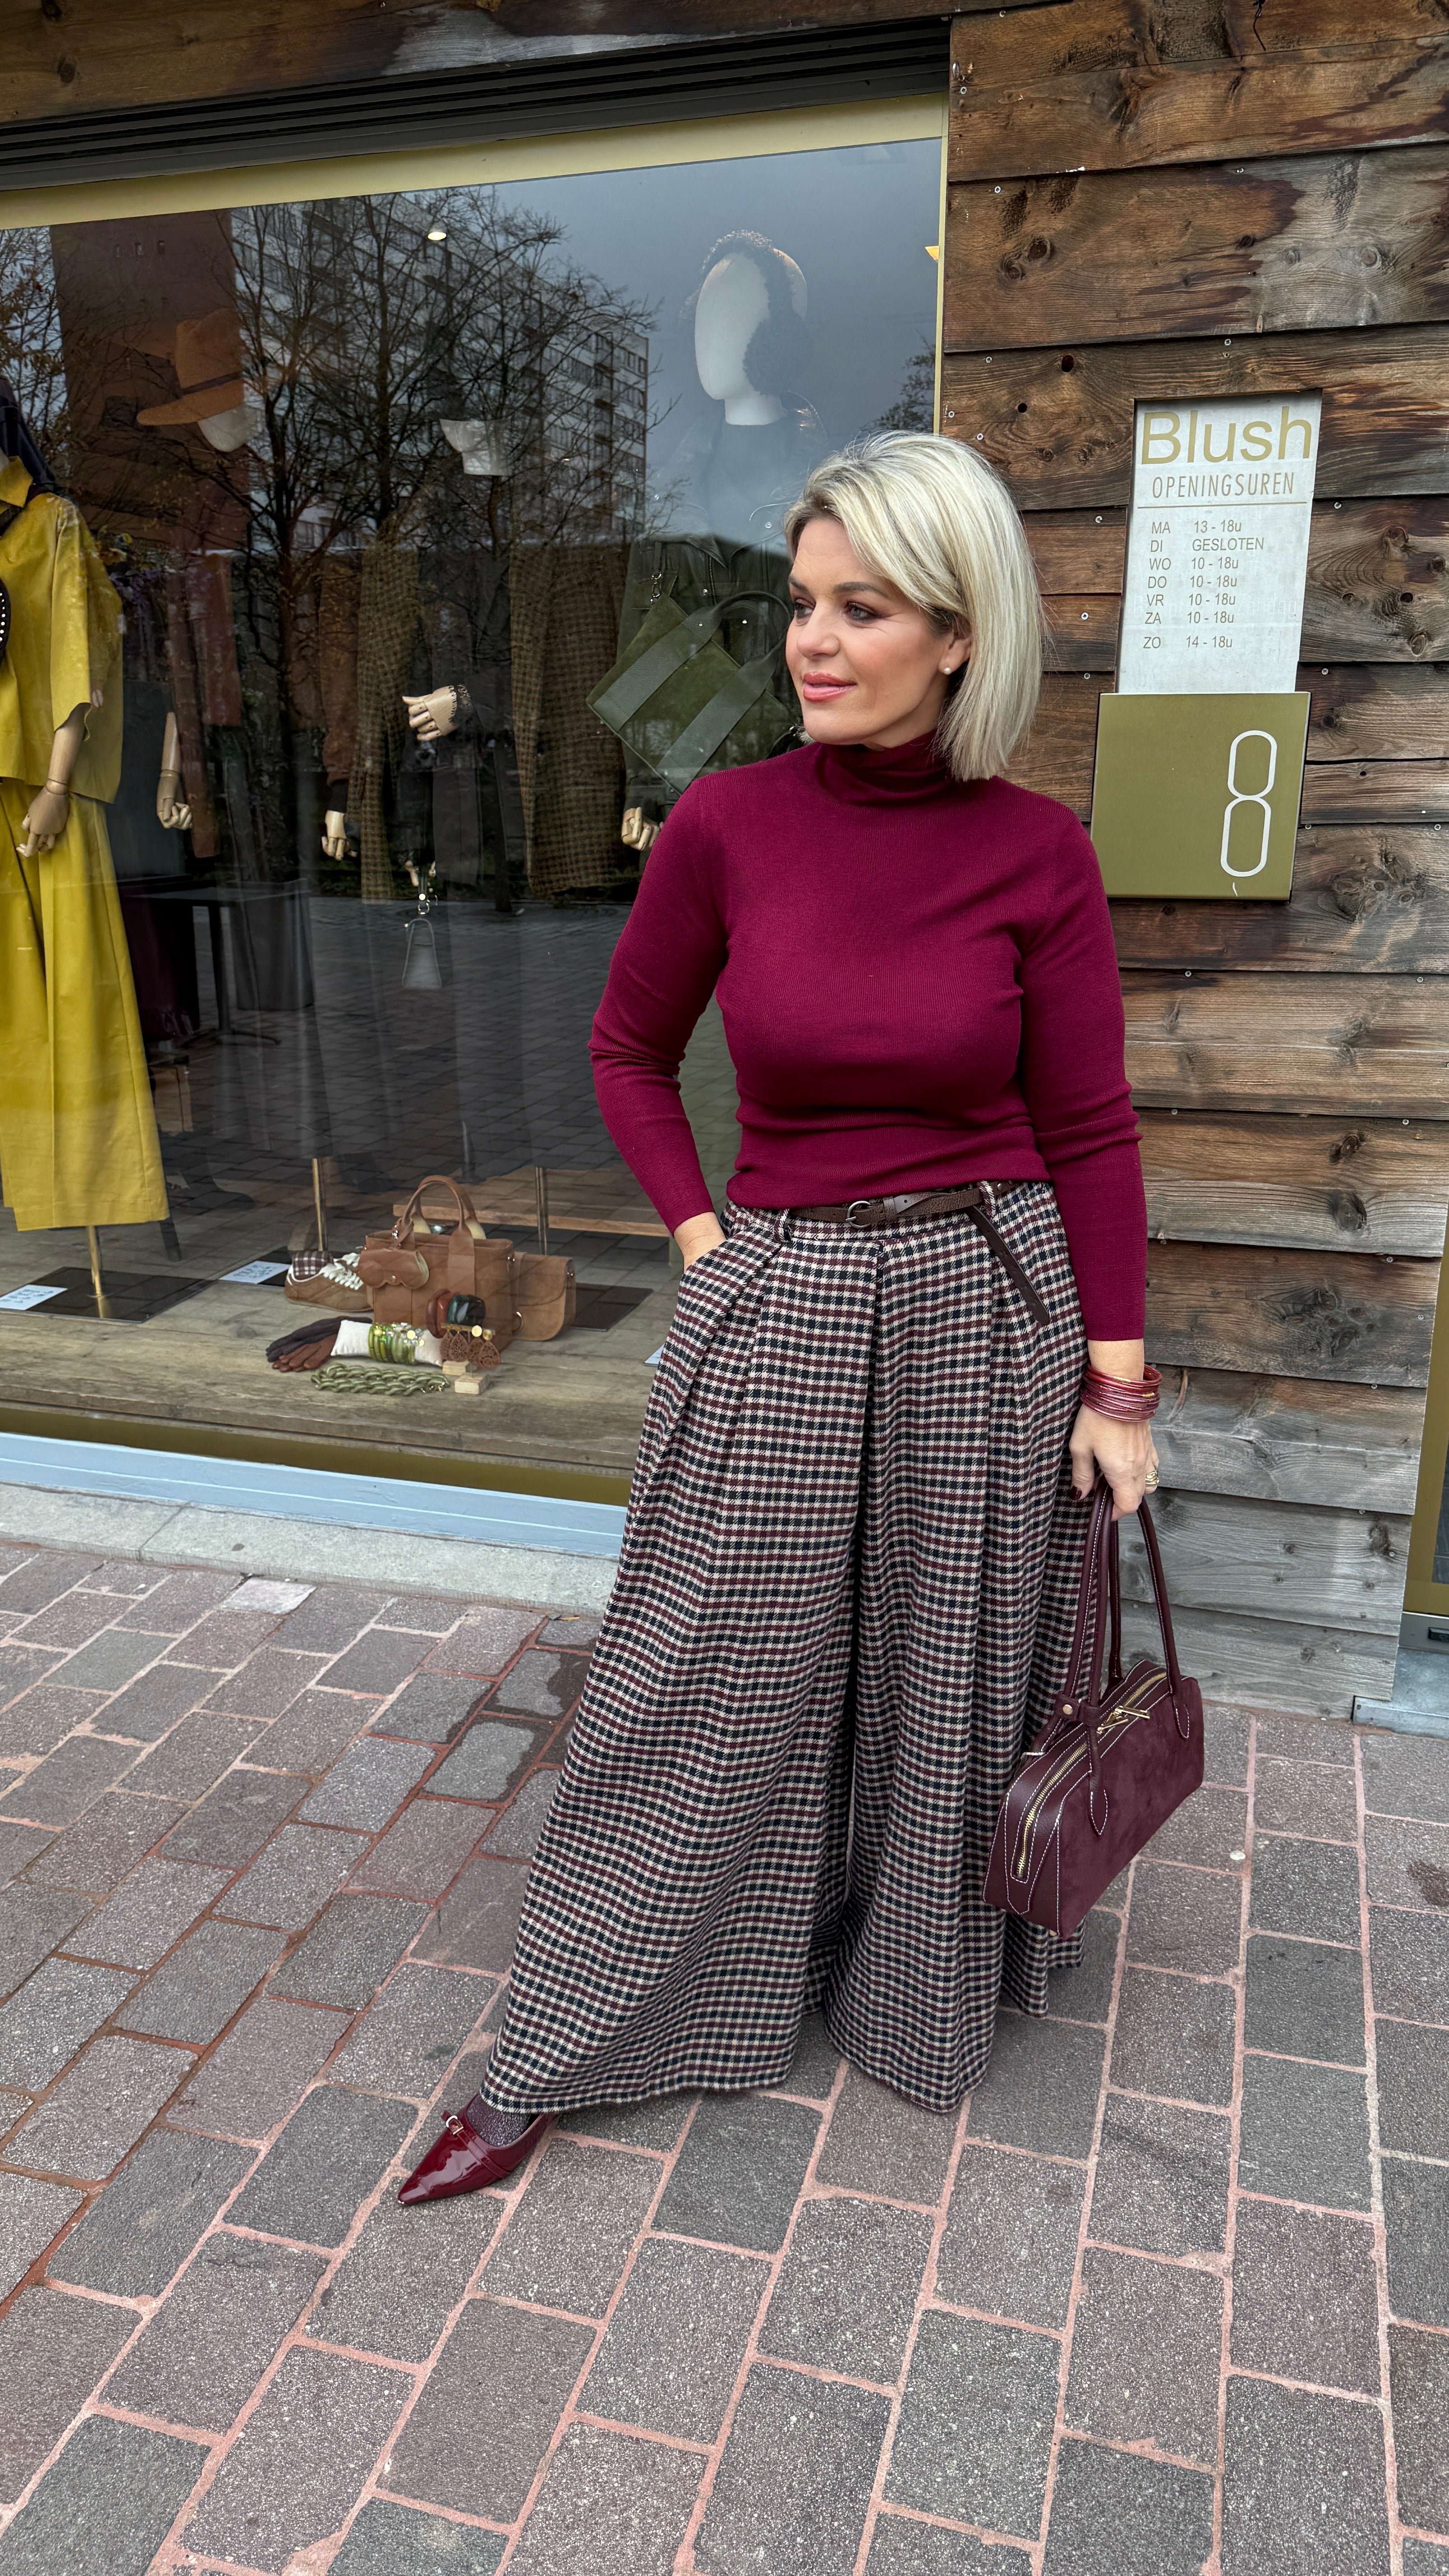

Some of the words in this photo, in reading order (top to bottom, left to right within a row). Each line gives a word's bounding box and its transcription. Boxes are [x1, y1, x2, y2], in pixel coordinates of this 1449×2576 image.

[1141, 406, 1312, 465] Blush
[1152, 472, 1294, 498] OPENINGSUREN
[1151, 521, 1171, 534] MA
[1194, 520, 1208, 533] 13
[1221, 519, 1242, 533] 18u
[1150, 539, 1163, 552] DI
[1192, 537, 1265, 552] GESLOTEN
[1149, 557, 1171, 570] WO
[1191, 557, 1205, 570] 10
[1218, 556, 1239, 569] 18u
[1148, 575, 1167, 589] DO
[1190, 575, 1204, 588] 10
[1216, 575, 1237, 588] 18u
[1146, 594, 1164, 607] VR
[1188, 593, 1202, 606] 10
[1215, 593, 1236, 605] 18u
[1144, 612, 1162, 625] ZA
[1187, 611, 1201, 624] 10
[1214, 611, 1234, 624] 18u
[1143, 636, 1161, 649] ZO
[1186, 635, 1199, 648] 14
[1212, 635, 1233, 648] 18u
[1220, 730, 1277, 877] 8
